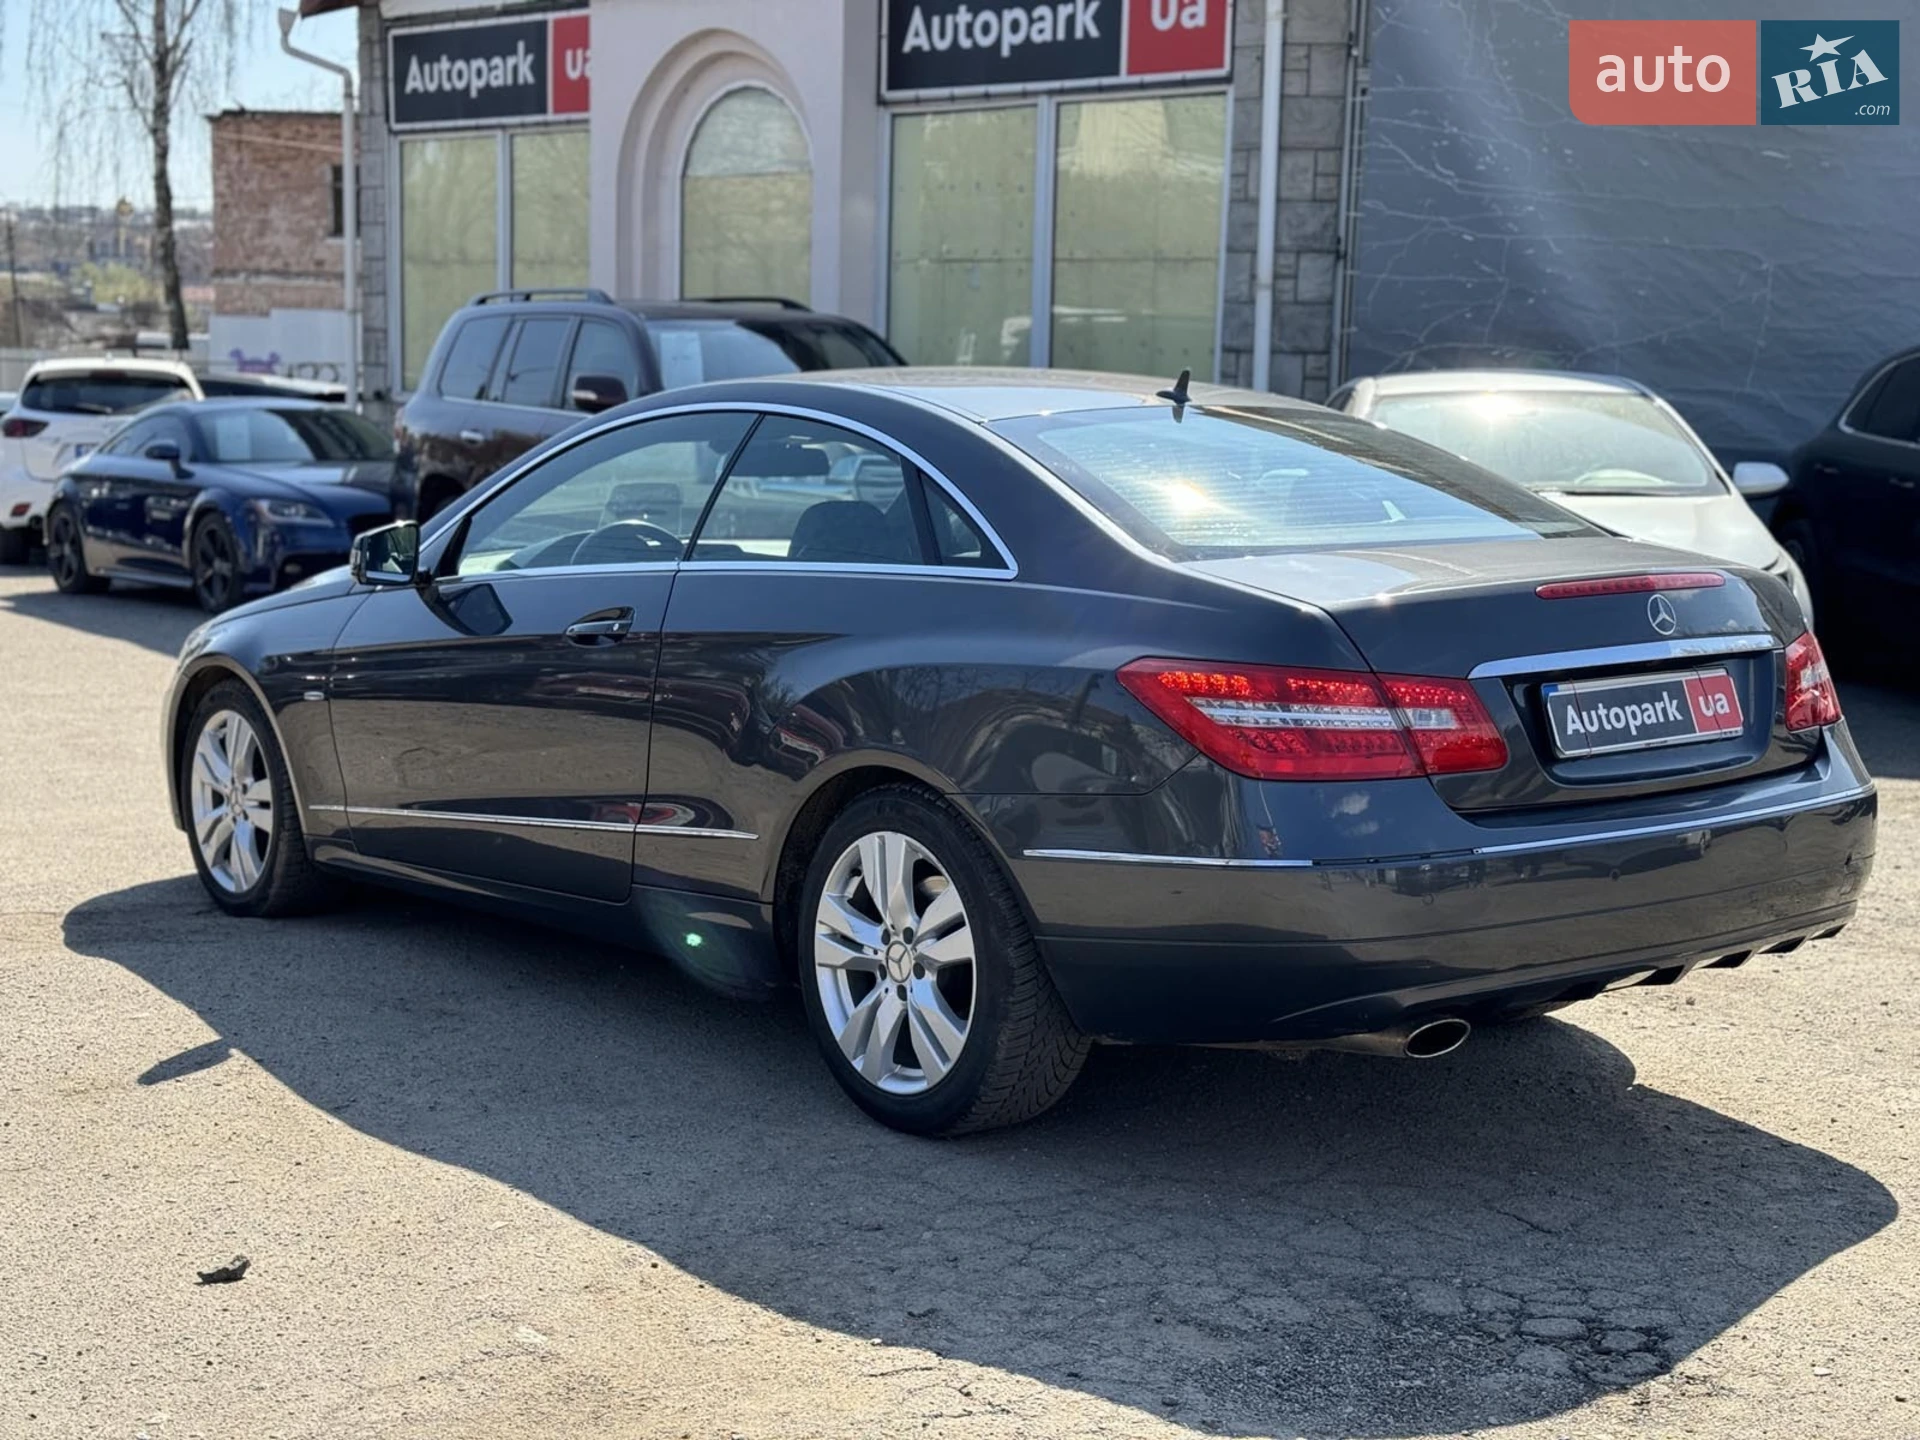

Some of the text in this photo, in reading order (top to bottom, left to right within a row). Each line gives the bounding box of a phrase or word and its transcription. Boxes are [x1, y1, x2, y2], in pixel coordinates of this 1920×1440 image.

[902, 0, 1100, 58] Autopark
[404, 39, 535, 99] Autopark
[1566, 691, 1731, 736] Autopark ua
